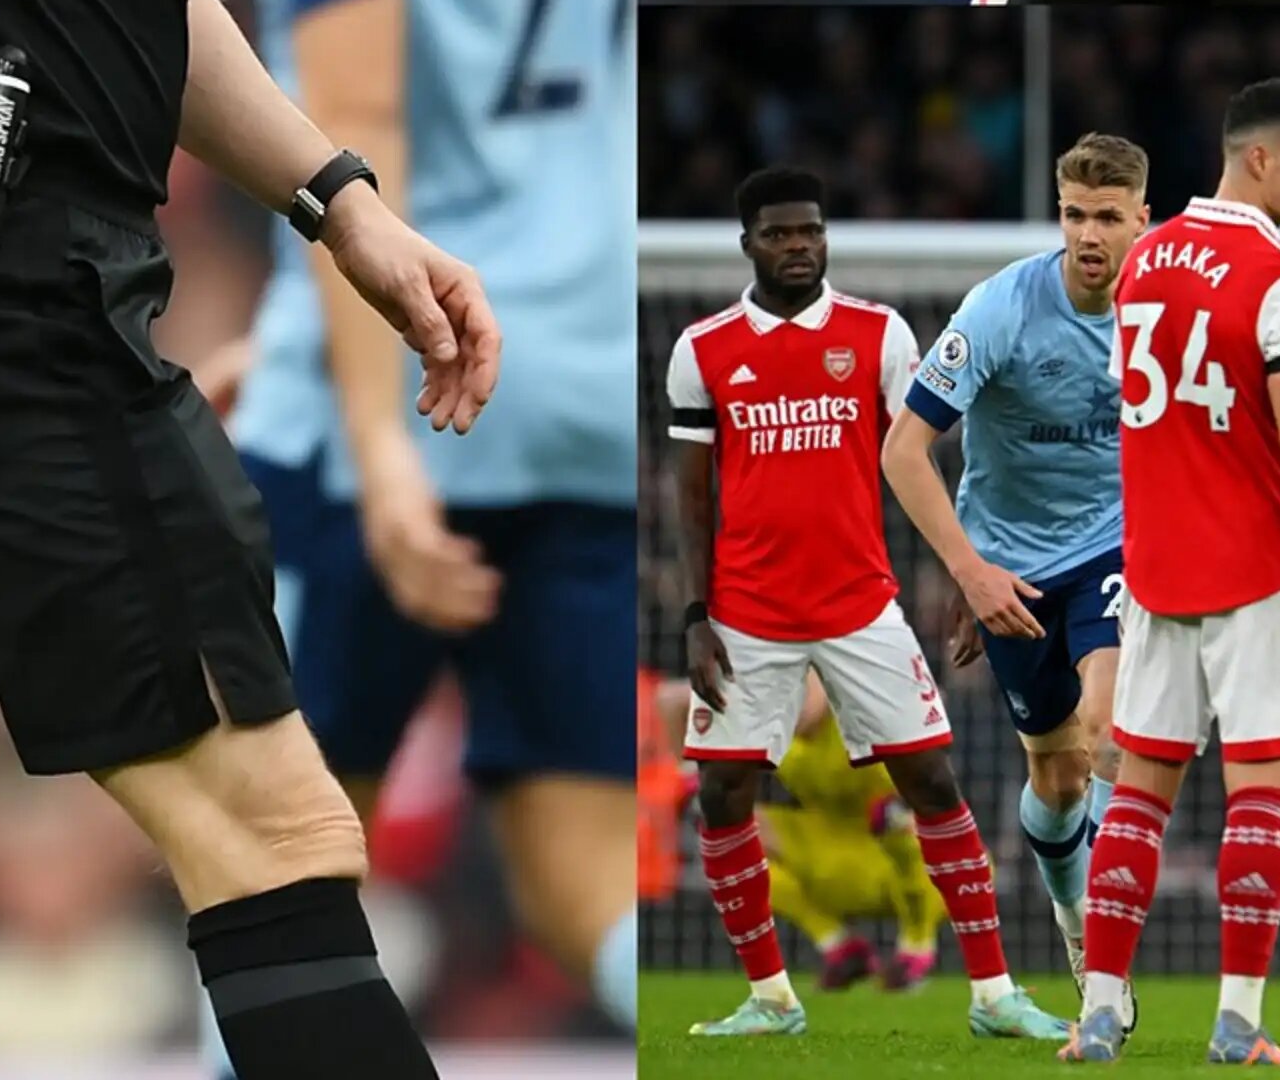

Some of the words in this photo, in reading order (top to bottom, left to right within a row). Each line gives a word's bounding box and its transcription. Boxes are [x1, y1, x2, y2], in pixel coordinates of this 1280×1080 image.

[1120, 302, 1236, 432] 34
[727, 393, 859, 429] Emirates
[750, 429, 777, 456] FLY
[781, 424, 842, 452] BETTER
